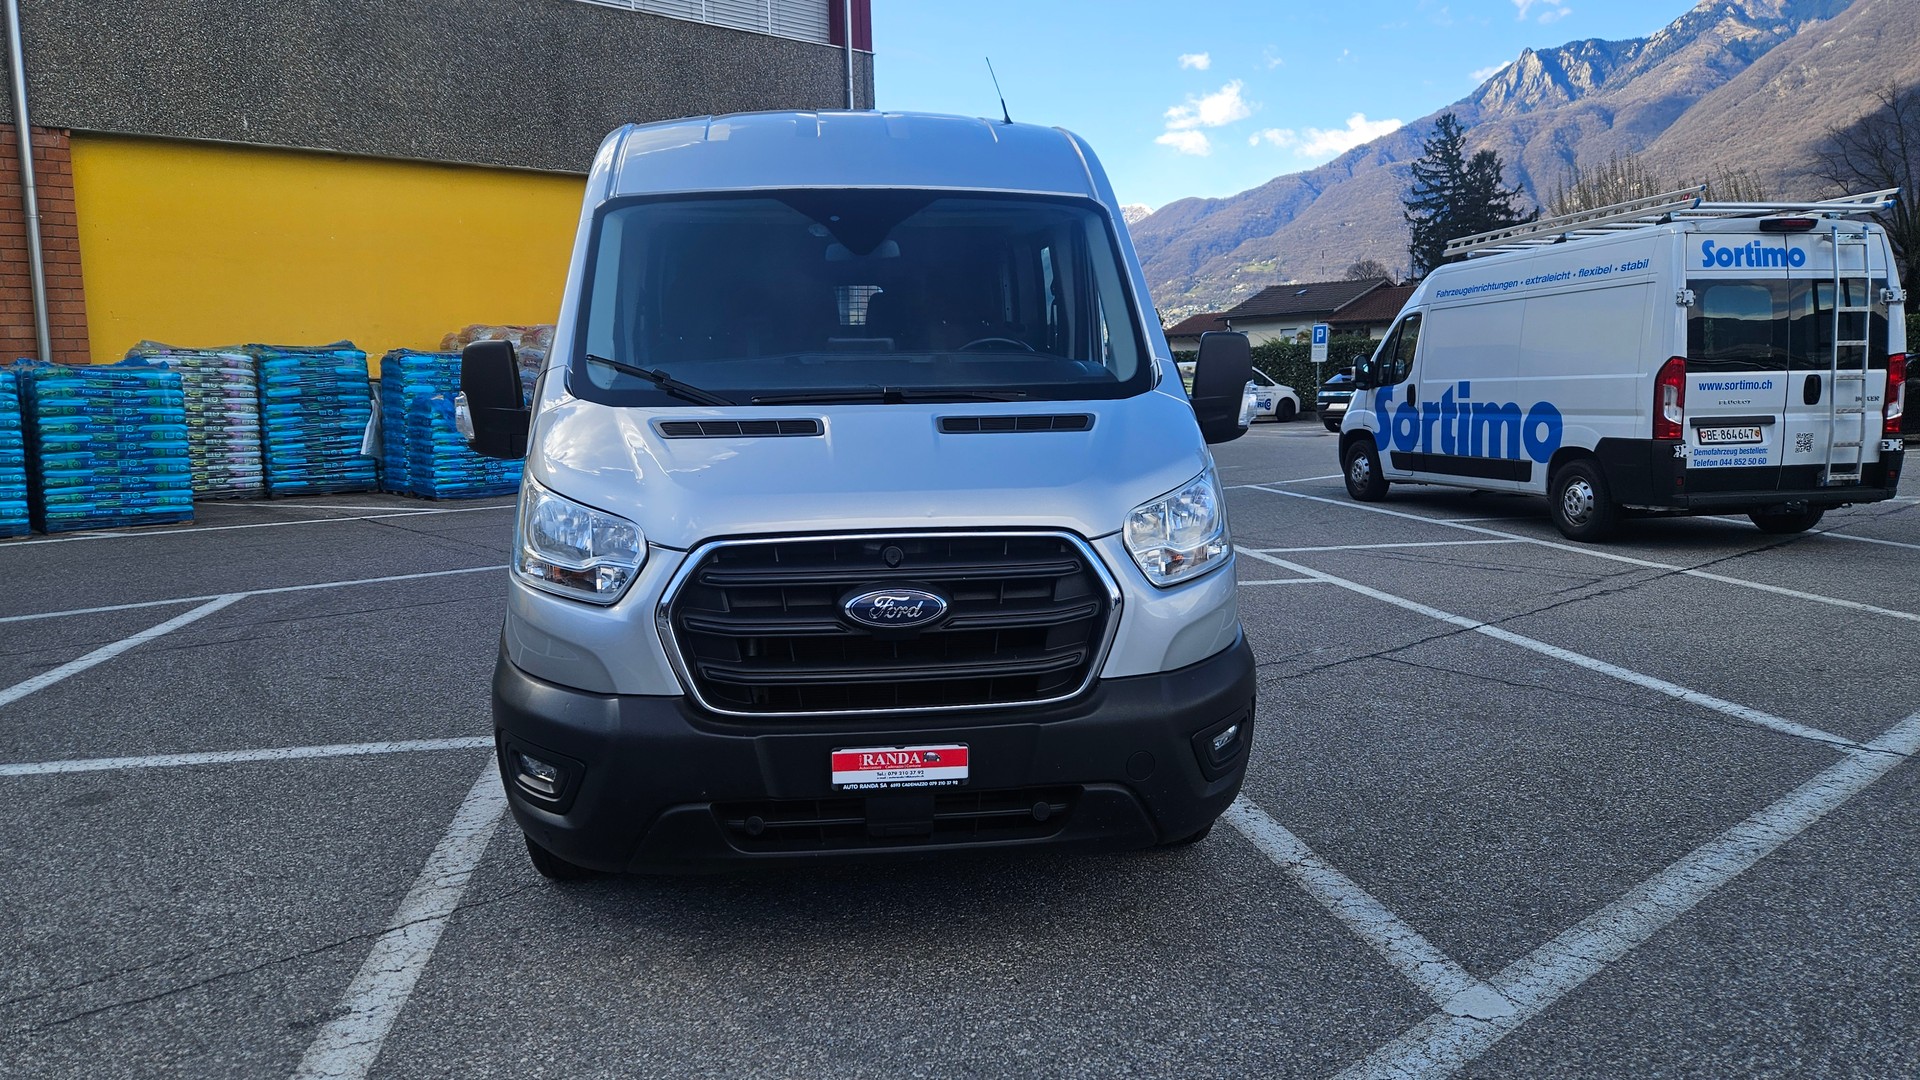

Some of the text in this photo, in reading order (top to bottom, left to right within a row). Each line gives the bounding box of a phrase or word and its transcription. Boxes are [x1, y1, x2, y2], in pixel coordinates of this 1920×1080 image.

[1701, 239, 1806, 268] Sortimo
[1435, 258, 1650, 298] Fahrzeugeinrichtungen extraleicht flexibel stabil
[1316, 328, 1324, 343] P
[1698, 379, 1773, 391] www.sortimo.ch
[1373, 380, 1563, 464] Sortimo
[1693, 446, 1768, 457] Demofahrzeug bestellen:
[1693, 457, 1767, 467] Telefon 044 852 50 60
[868, 595, 924, 619] Ford
[862, 751, 922, 766] RANDA
